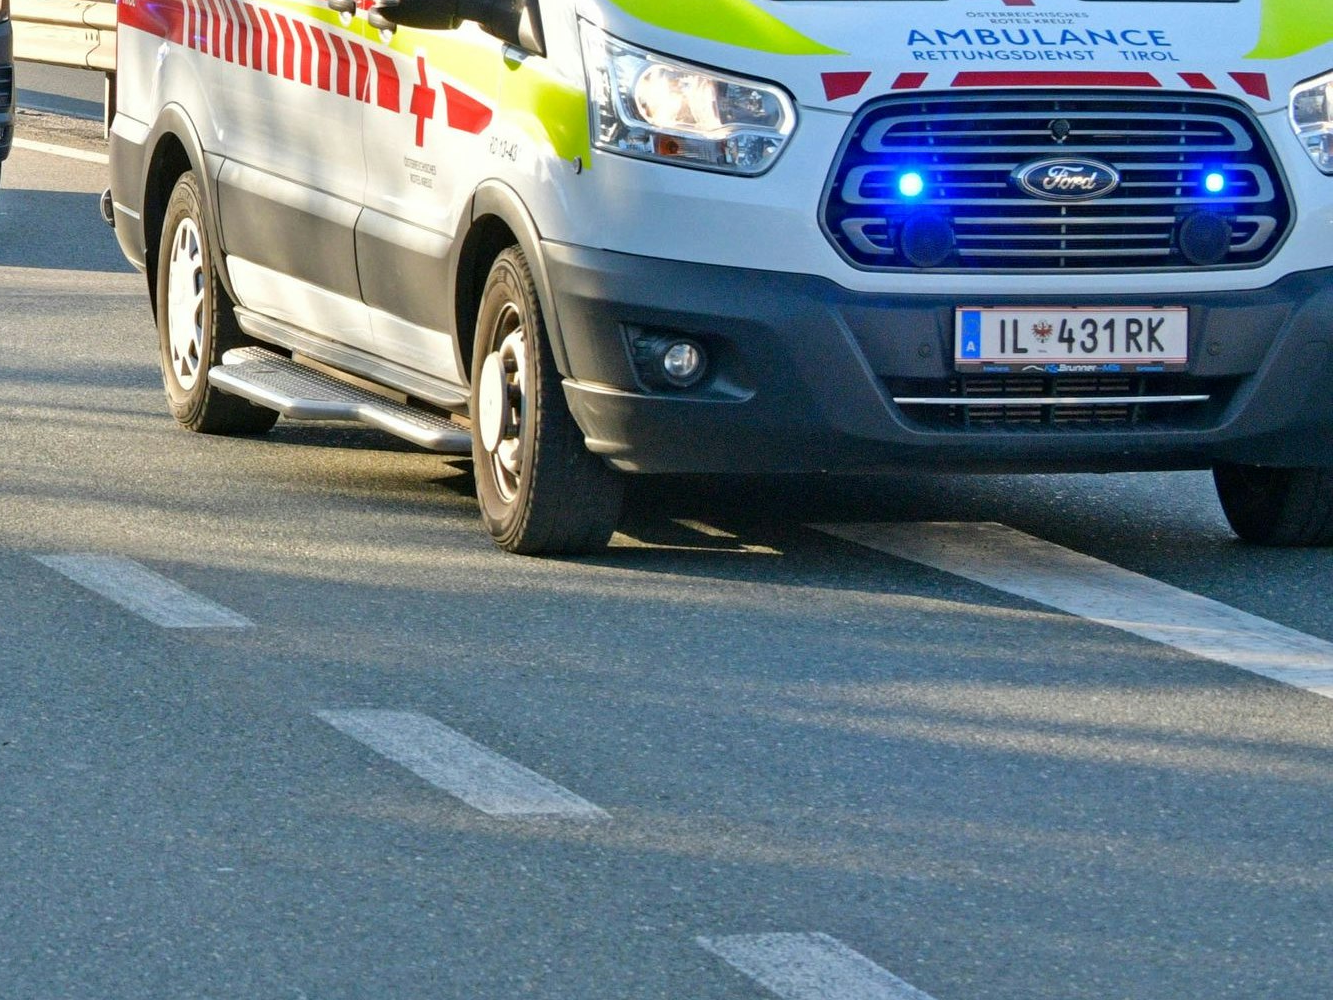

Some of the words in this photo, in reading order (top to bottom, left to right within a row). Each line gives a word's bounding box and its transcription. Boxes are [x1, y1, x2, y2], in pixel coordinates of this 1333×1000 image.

[966, 10, 1089, 19] ÖSTERREICHISCHES
[907, 28, 1172, 47] AMBULANCE
[913, 50, 1095, 61] RETTUNGSDIENST
[1120, 50, 1180, 62] TIROL
[1042, 165, 1098, 190] Ford
[1000, 319, 1029, 354] IL
